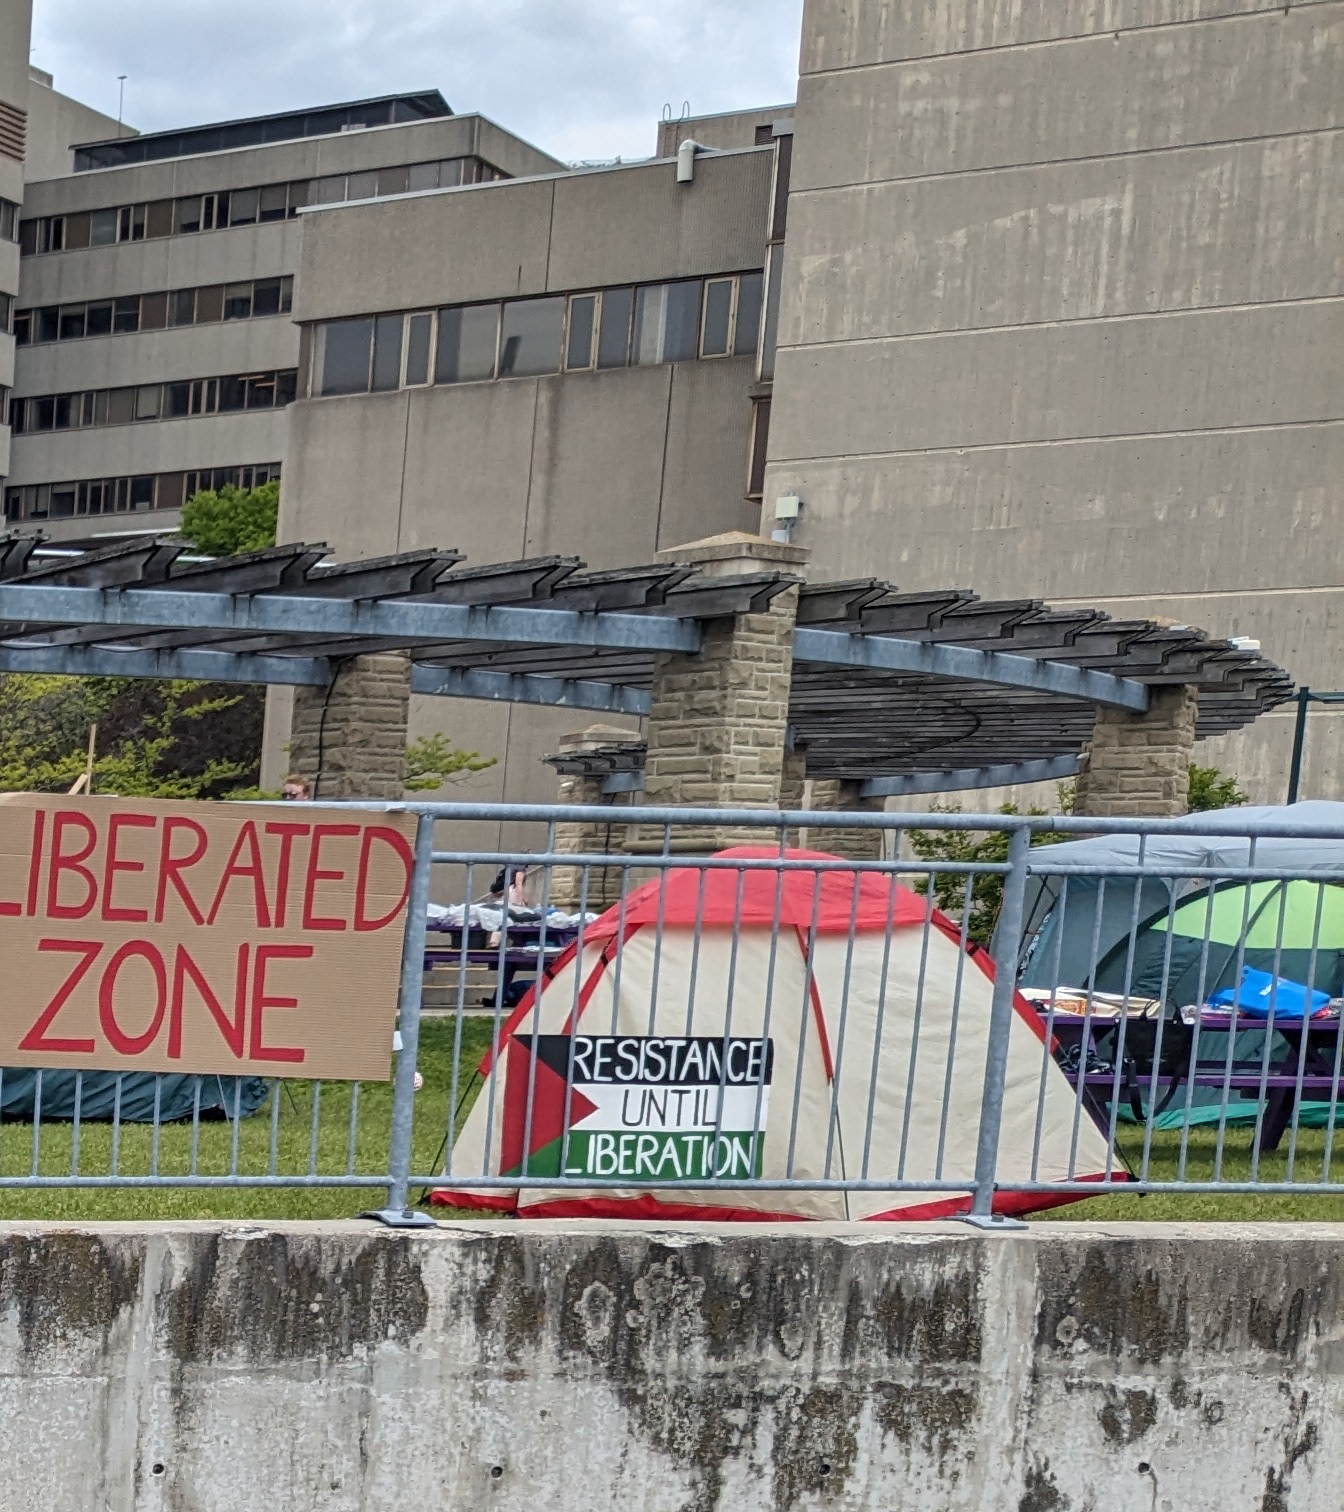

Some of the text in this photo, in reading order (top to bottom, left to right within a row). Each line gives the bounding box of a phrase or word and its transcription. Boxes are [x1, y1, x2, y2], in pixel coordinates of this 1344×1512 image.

[18, 939, 314, 1063] ZONE
[573, 1037, 763, 1083] RESISTANCE
[622, 1088, 716, 1127] UNTIL
[563, 1133, 754, 1178] LIBERATION
